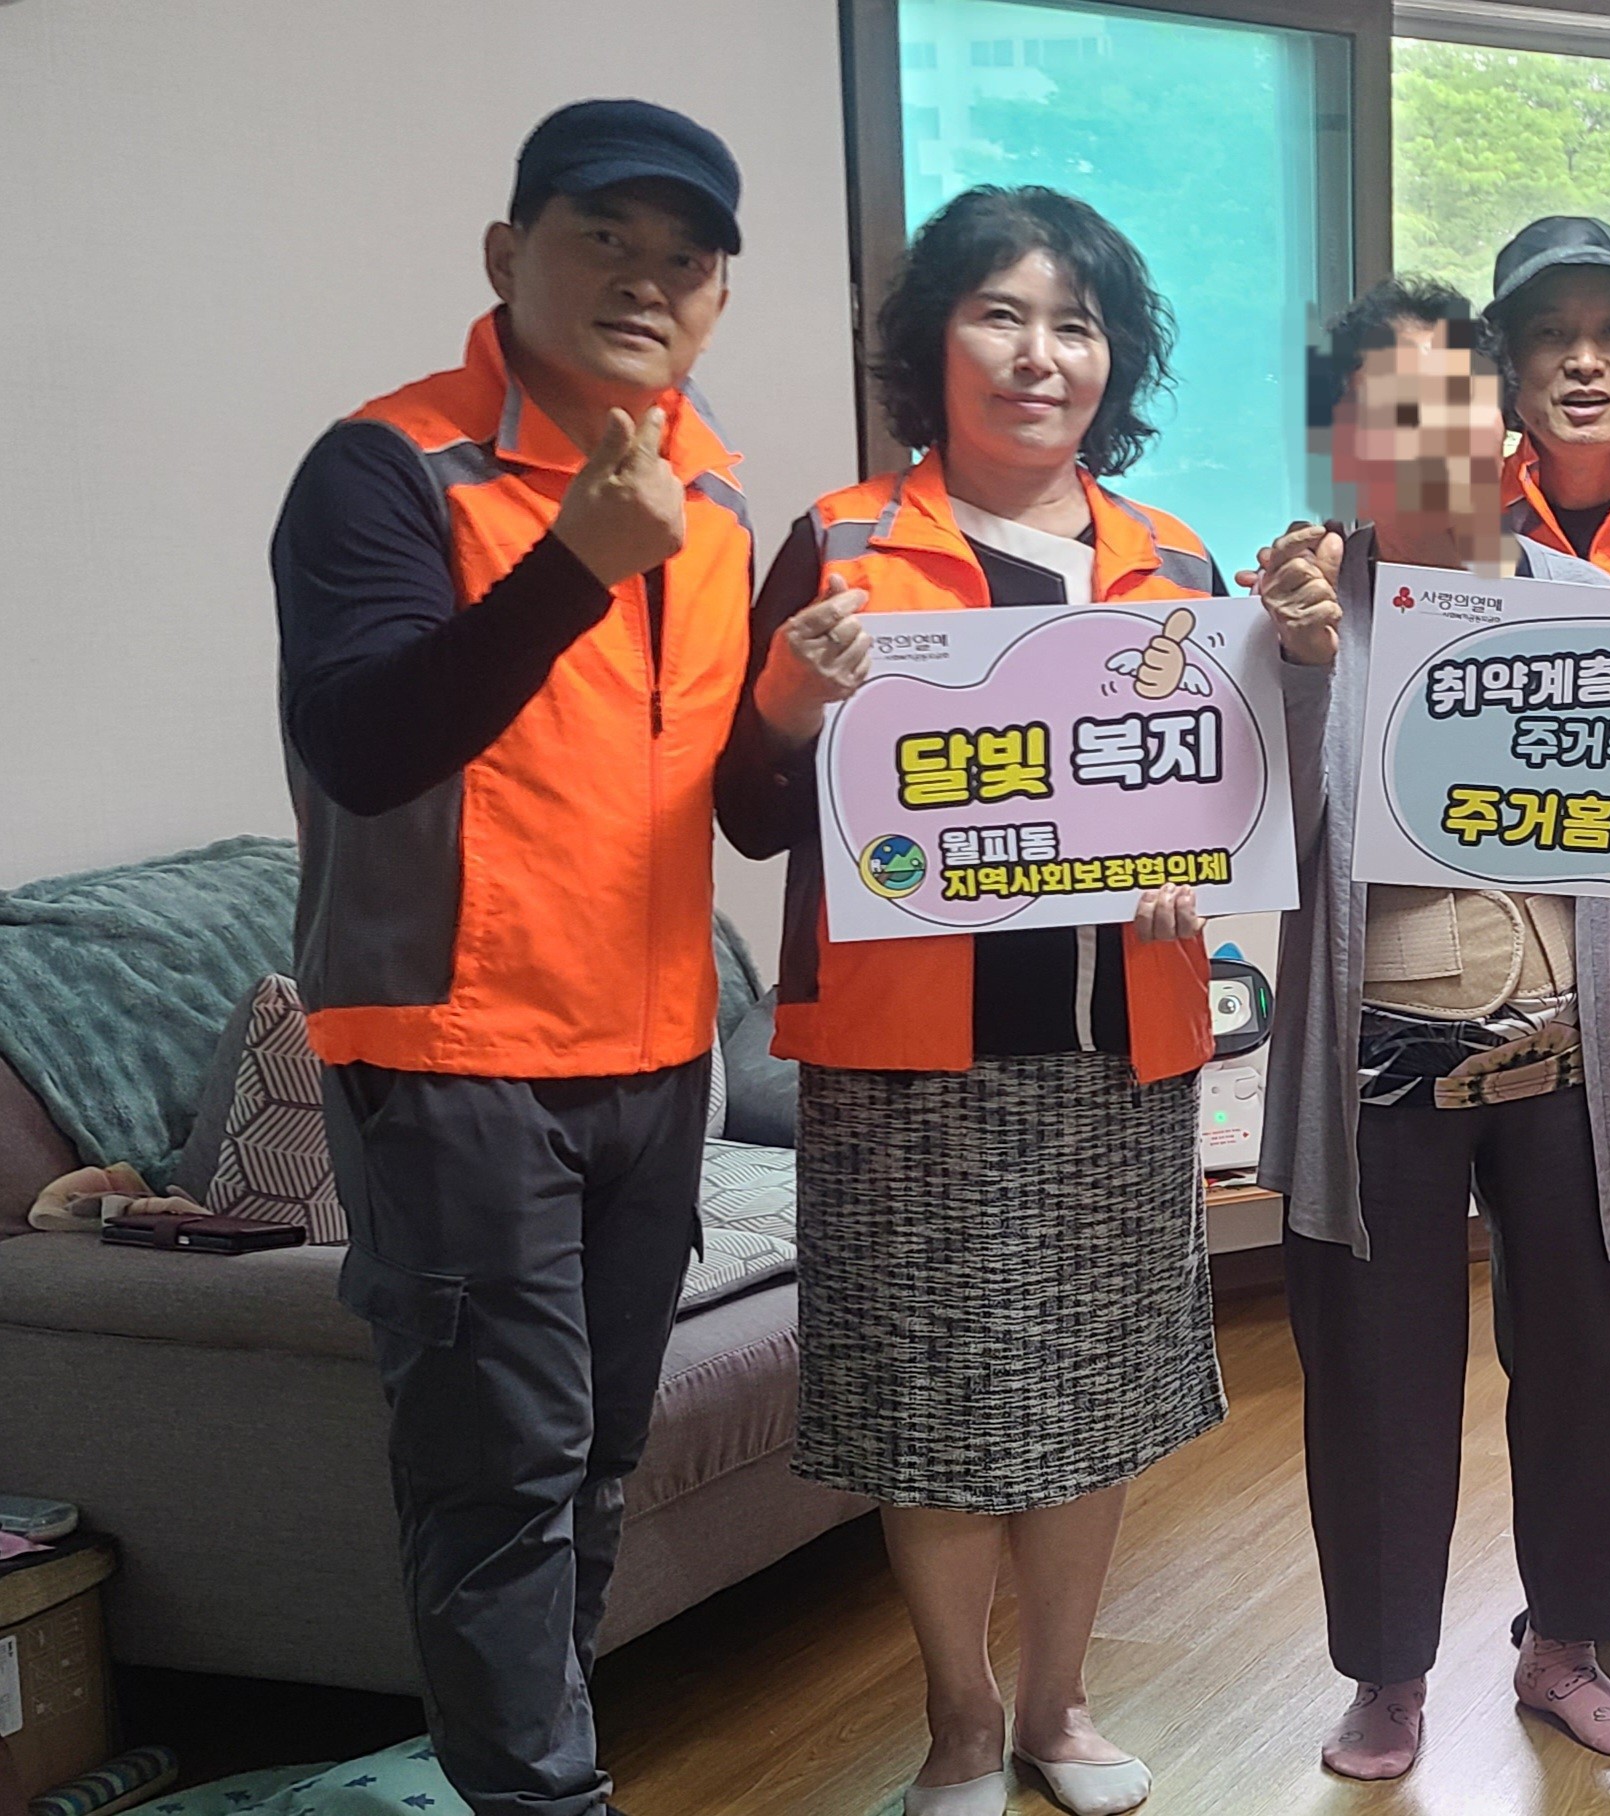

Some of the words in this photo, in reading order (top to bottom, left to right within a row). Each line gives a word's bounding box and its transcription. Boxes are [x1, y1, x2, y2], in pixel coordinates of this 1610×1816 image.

[1420, 591, 1503, 613] 사랑의열매
[871, 634, 949, 654] 랑의열매
[898, 723, 1051, 808] 달빛
[1073, 708, 1221, 789] 복지
[941, 824, 1057, 866] 월피동
[943, 850, 1230, 899] 지역사회보장협의체
